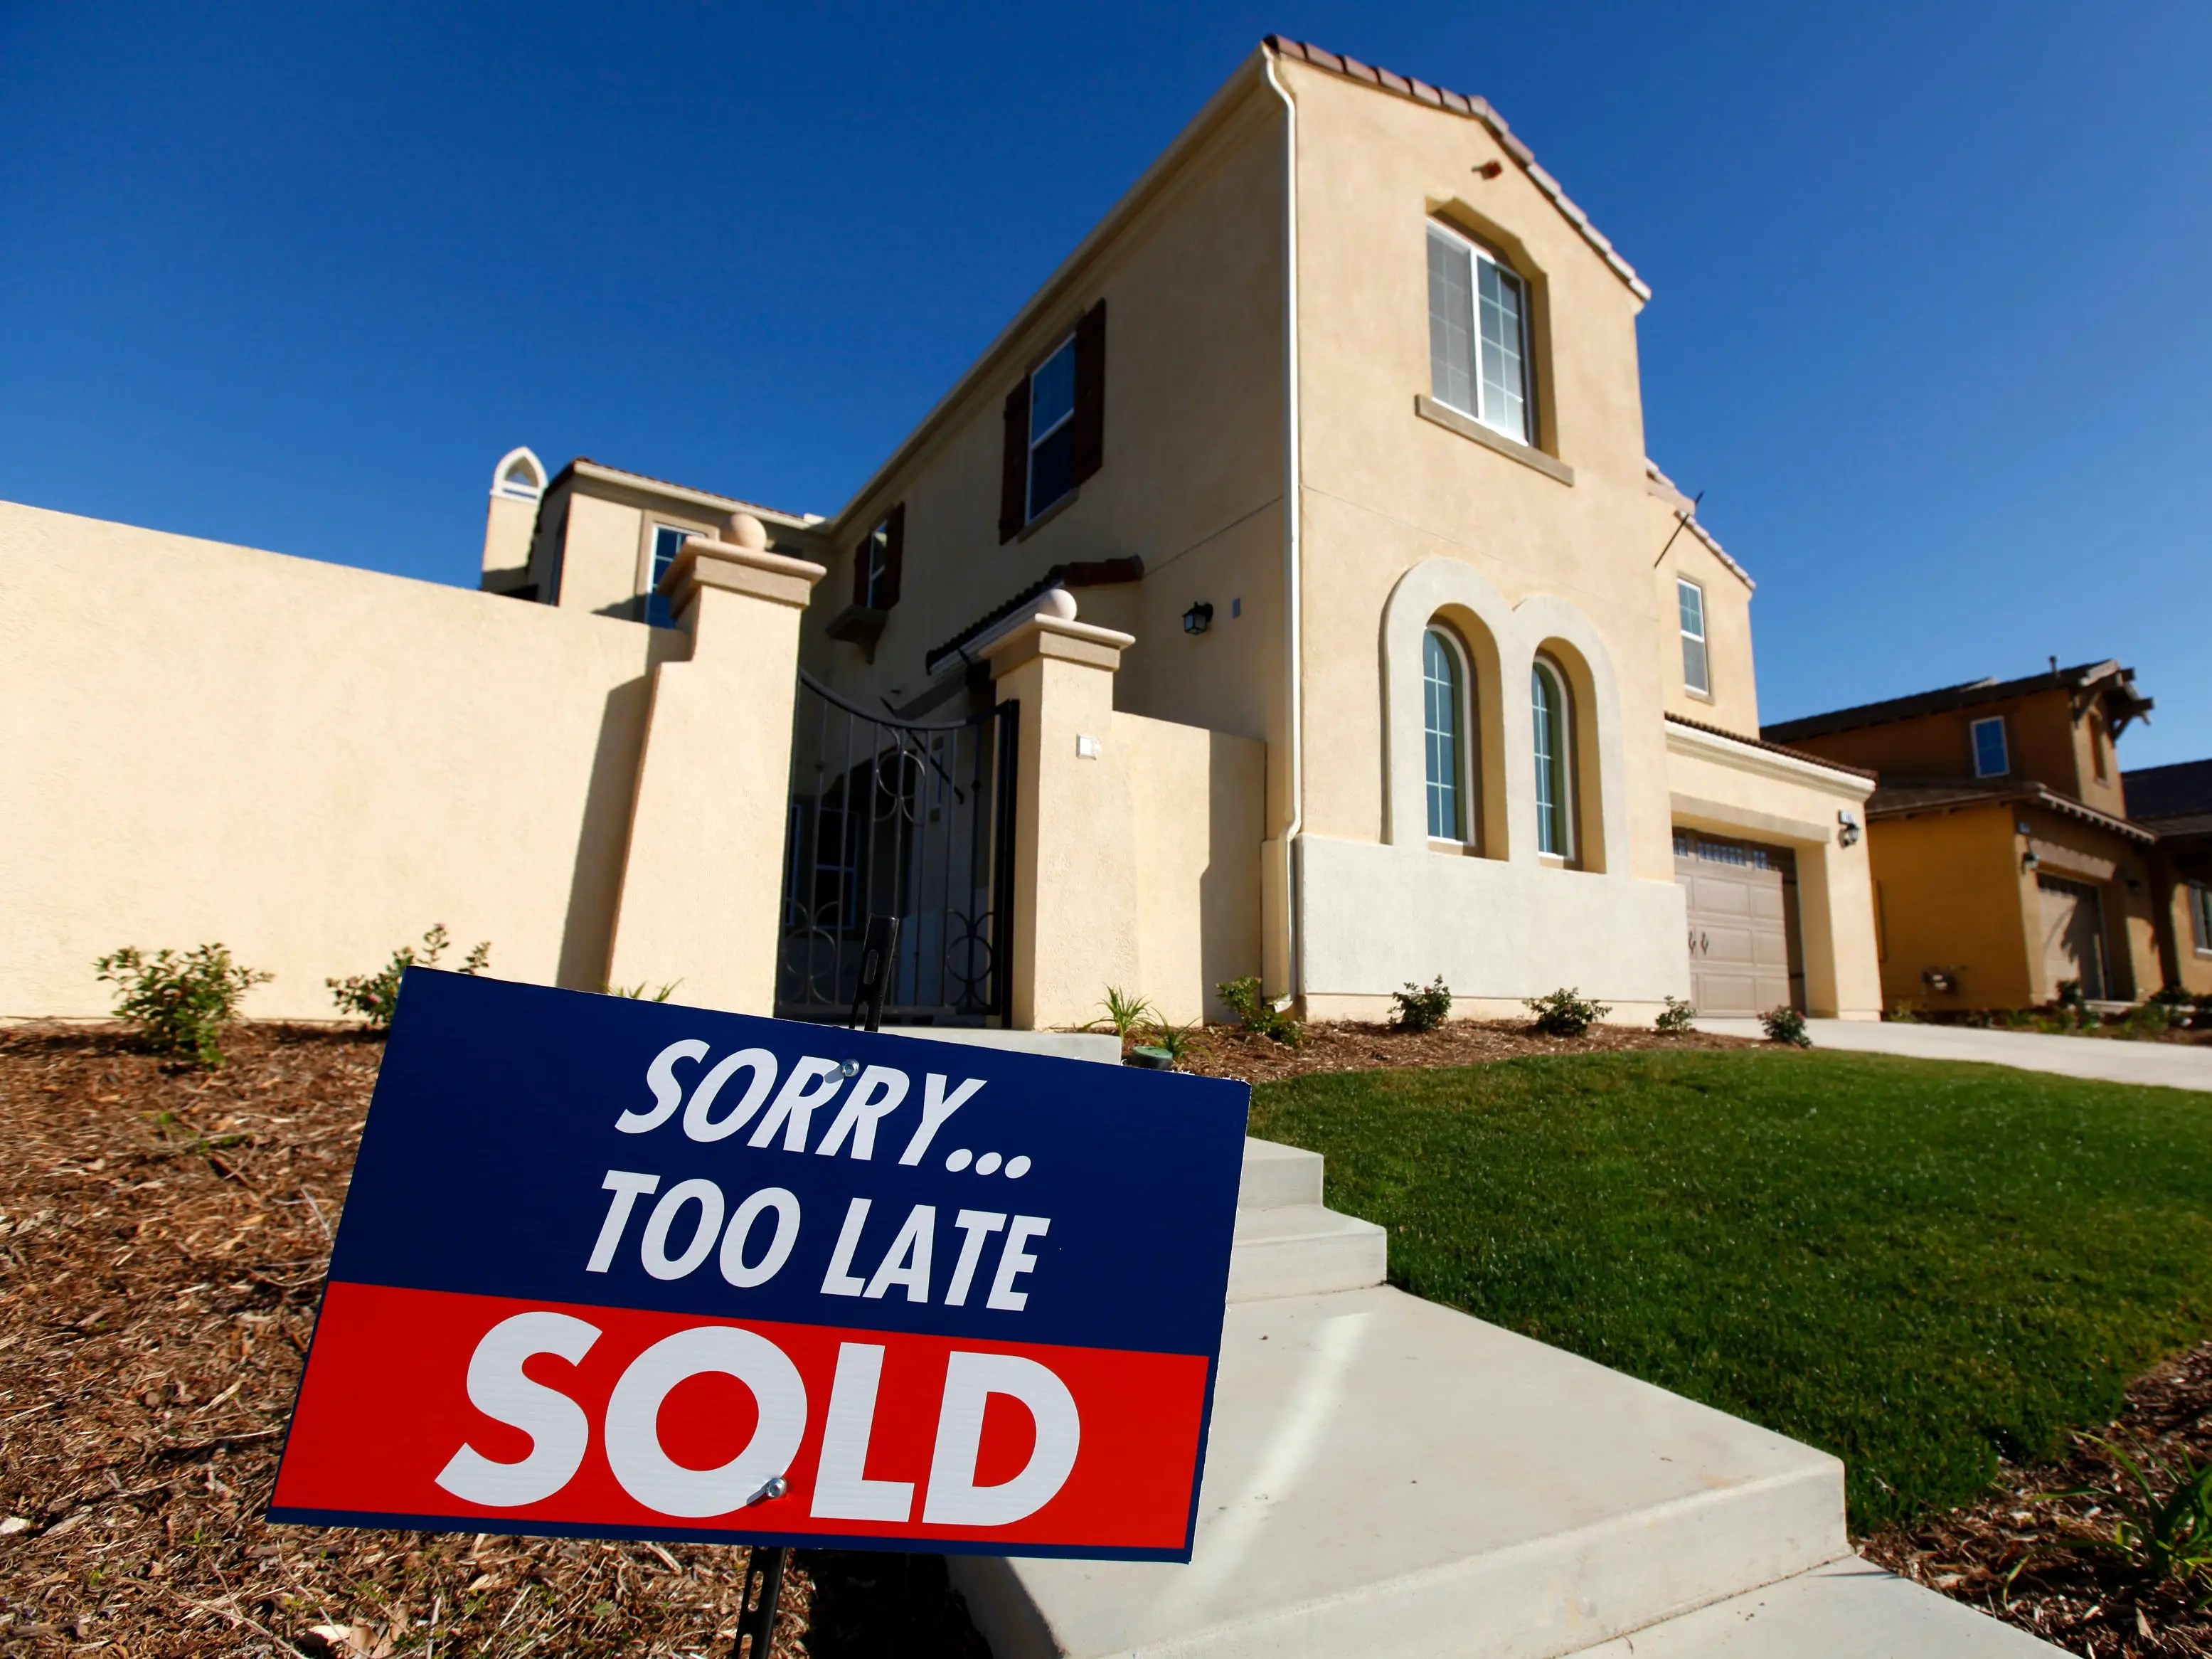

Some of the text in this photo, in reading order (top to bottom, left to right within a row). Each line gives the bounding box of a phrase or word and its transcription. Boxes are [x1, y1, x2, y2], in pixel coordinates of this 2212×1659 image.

[615, 1039, 1031, 1179] SORRY...
[585, 1170, 1051, 1312] TOO LATE
[434, 1311, 1080, 1527] SOLD
